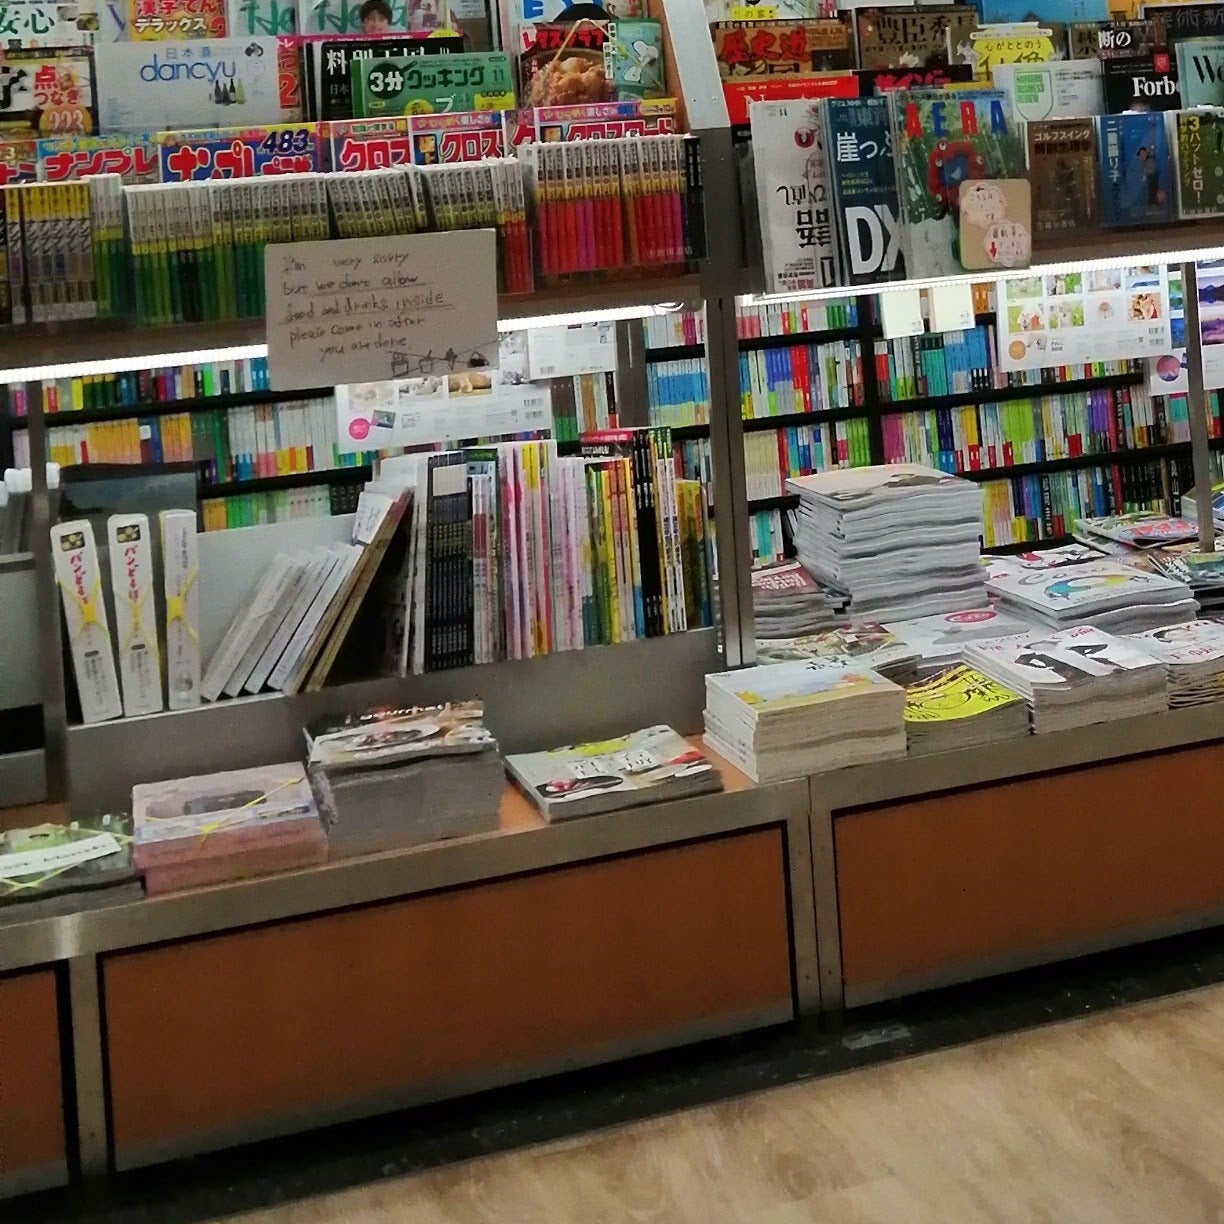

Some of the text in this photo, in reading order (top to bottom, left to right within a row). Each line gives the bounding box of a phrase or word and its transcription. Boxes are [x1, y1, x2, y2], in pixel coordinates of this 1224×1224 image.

[134, 17, 207, 33] デラックス
[140, 53, 237, 83] dancyu
[369, 66, 485, 93] 3分クッキング
[905, 99, 1008, 138] AERA
[262, 128, 310, 154] 483
[1033, 129, 1090, 142] ゴルフスイング
[332, 256, 363, 271] very
[372, 251, 409, 265] sorry
[316, 279, 334, 291] we
[381, 273, 418, 288] allow
[286, 289, 444, 323] food and drinks inside
[319, 342, 345, 362] you
[351, 338, 372, 352] are
